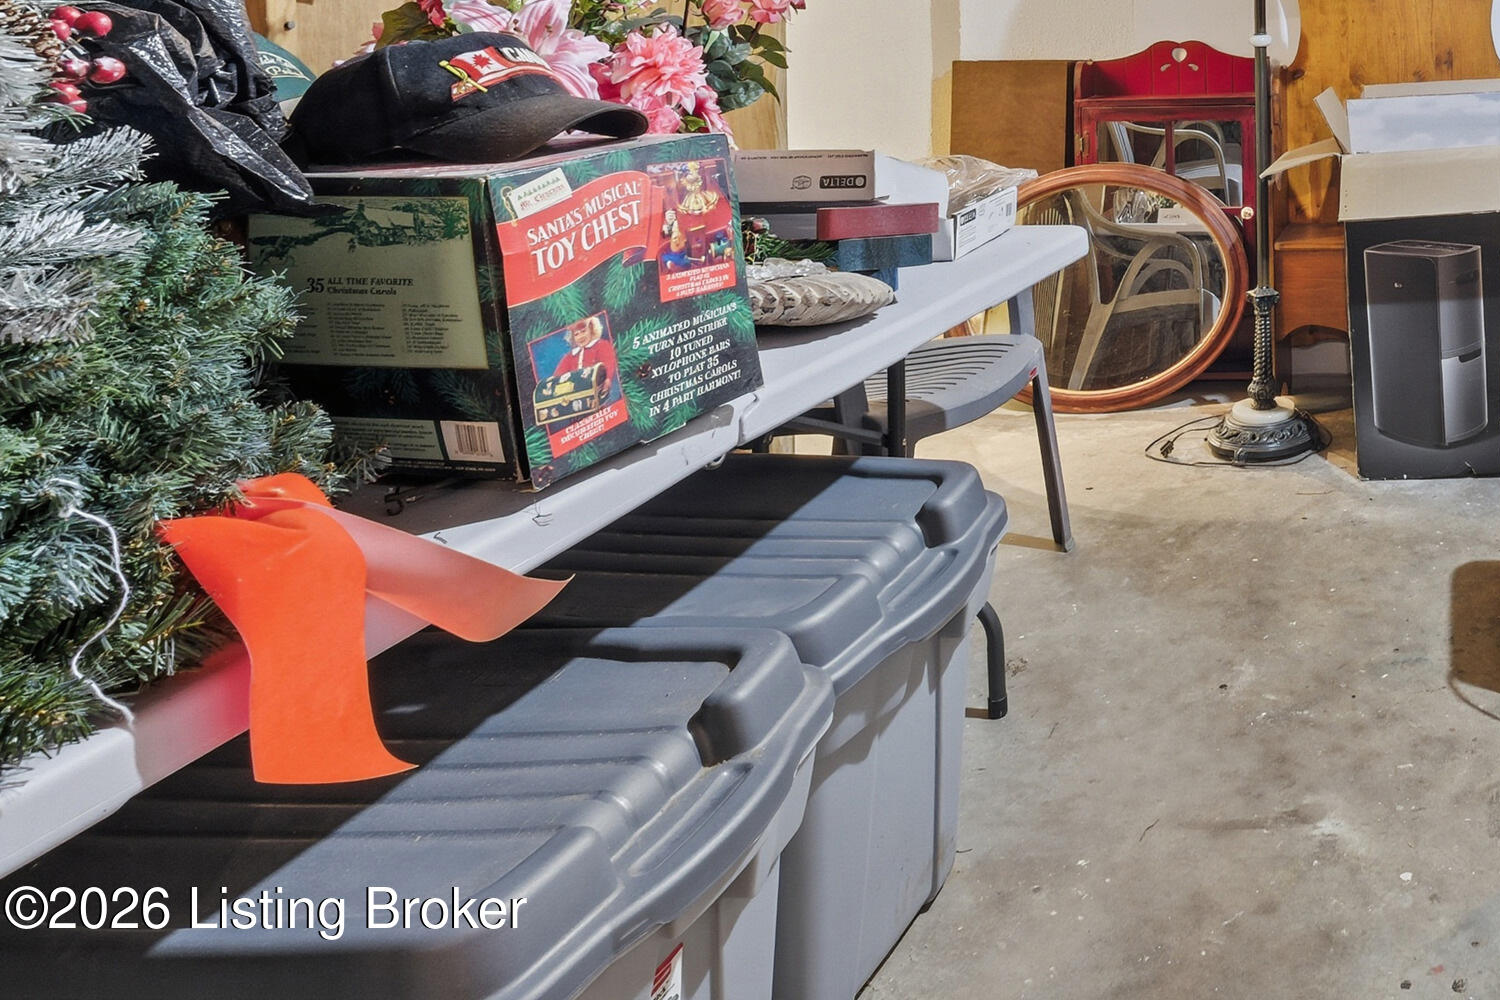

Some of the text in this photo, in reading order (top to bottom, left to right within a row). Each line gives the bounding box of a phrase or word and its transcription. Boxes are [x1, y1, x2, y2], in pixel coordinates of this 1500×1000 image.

[822, 177, 854, 187] DELTA
[527, 181, 640, 246] SANTA'S MUSICAL
[531, 200, 640, 276] TOY CHEST
[307, 277, 325, 293] 35
[328, 277, 414, 286] ALL TIME FAVORITE
[633, 302, 738, 349] 5 ANIMATED MUSICIANS
[648, 317, 728, 354] TURN AND STRIKE
[651, 339, 731, 378] XYLOPHONE BARS
[670, 335, 713, 360] 10 TUNED
[650, 360, 738, 404] CHRISTMAS CAROLS
[668, 355, 719, 383] TO PLAY 35
[649, 405, 660, 417] IN
[663, 400, 670, 412] 4
[672, 390, 694, 406] PART
